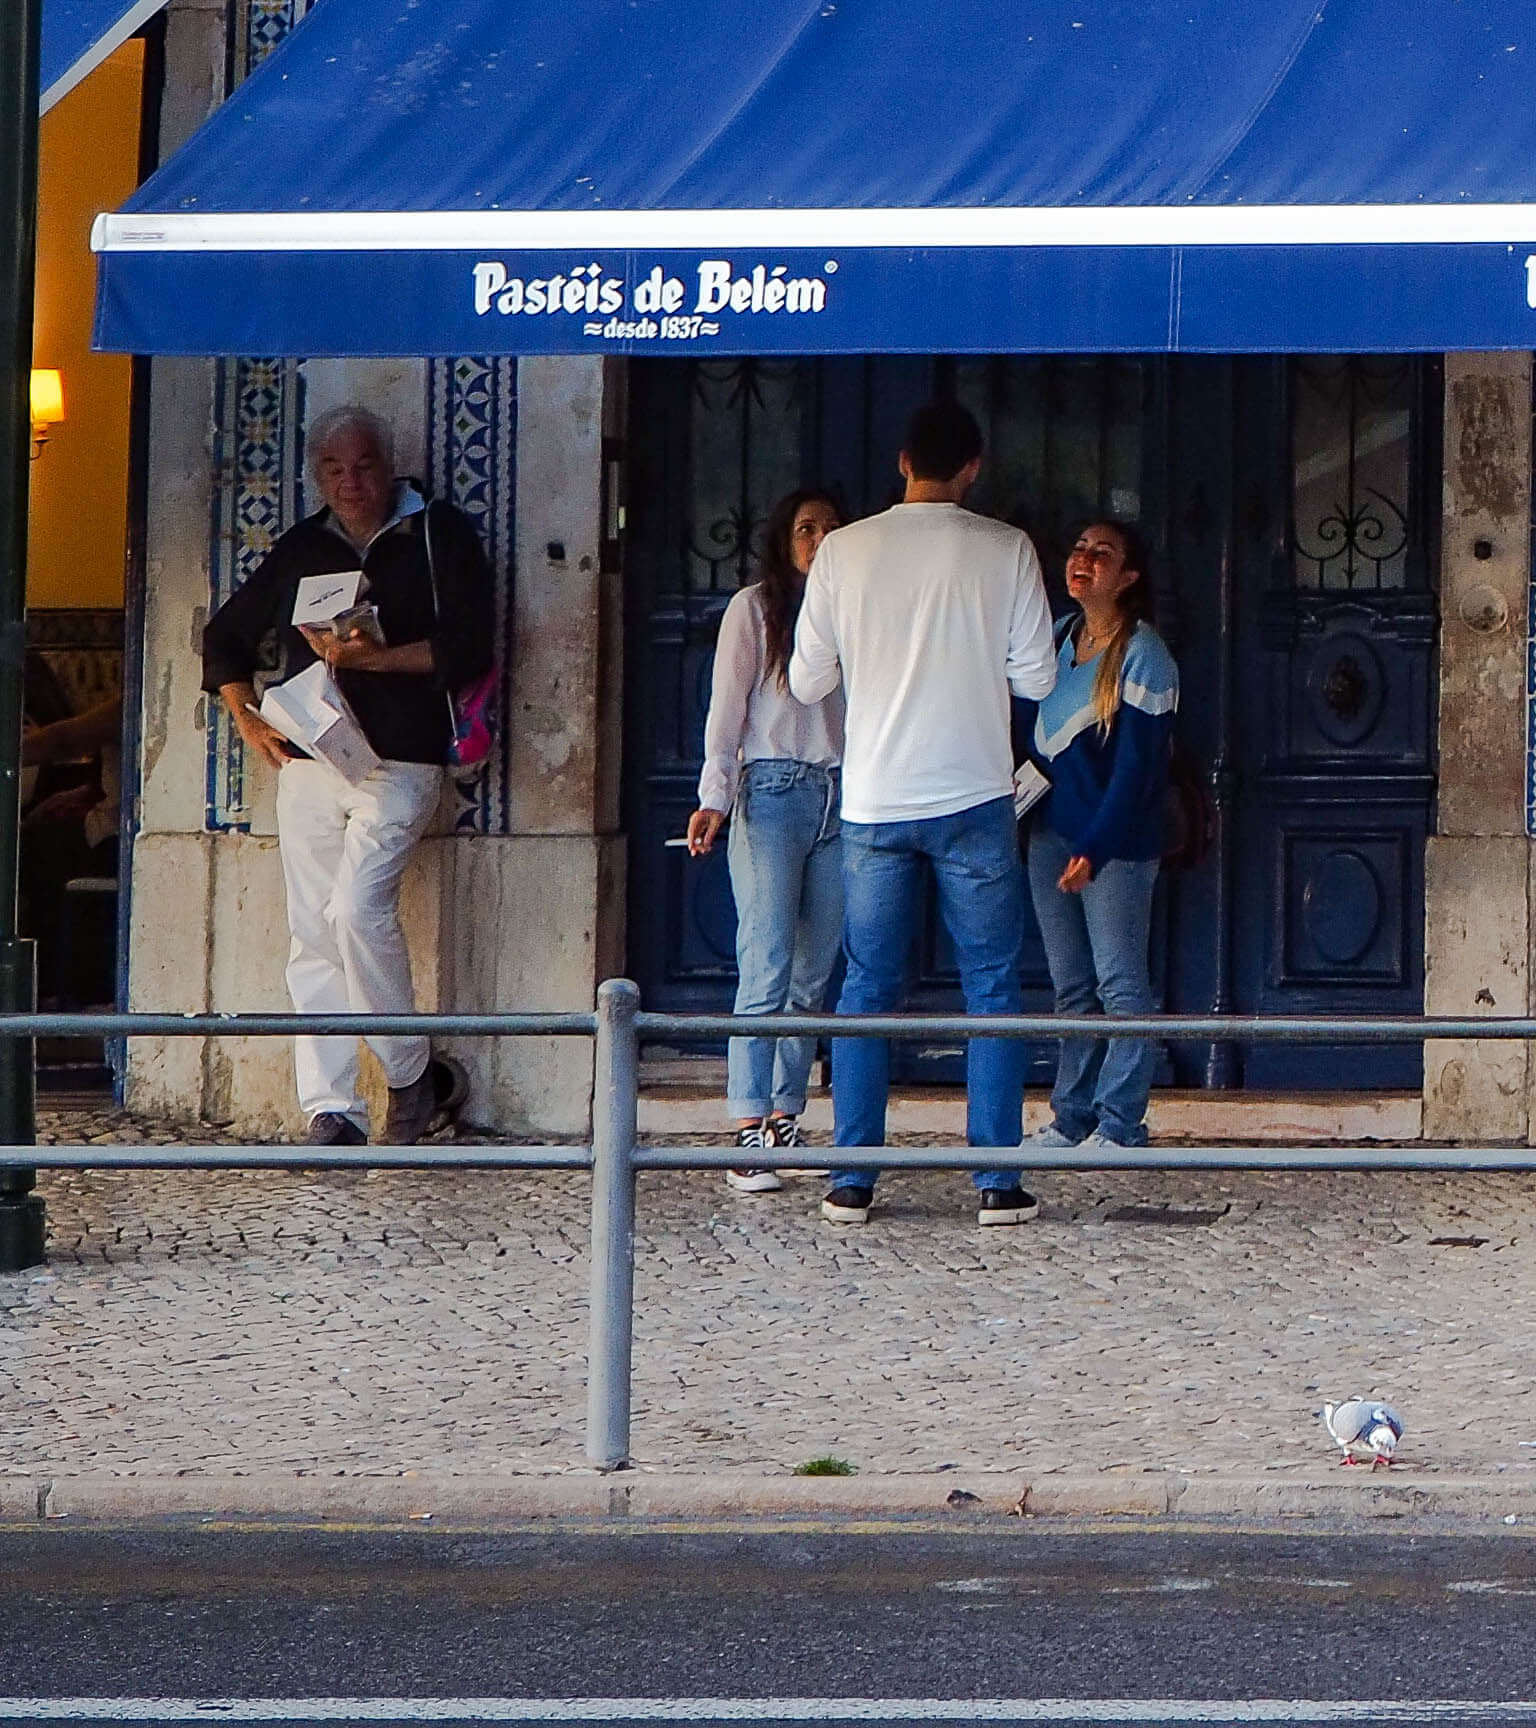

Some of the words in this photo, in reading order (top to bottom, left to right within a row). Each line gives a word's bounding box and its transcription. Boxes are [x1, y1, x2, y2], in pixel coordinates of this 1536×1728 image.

[472, 261, 624, 316] Pastéis
[633, 266, 685, 314] de
[660, 316, 703, 339] 1837
